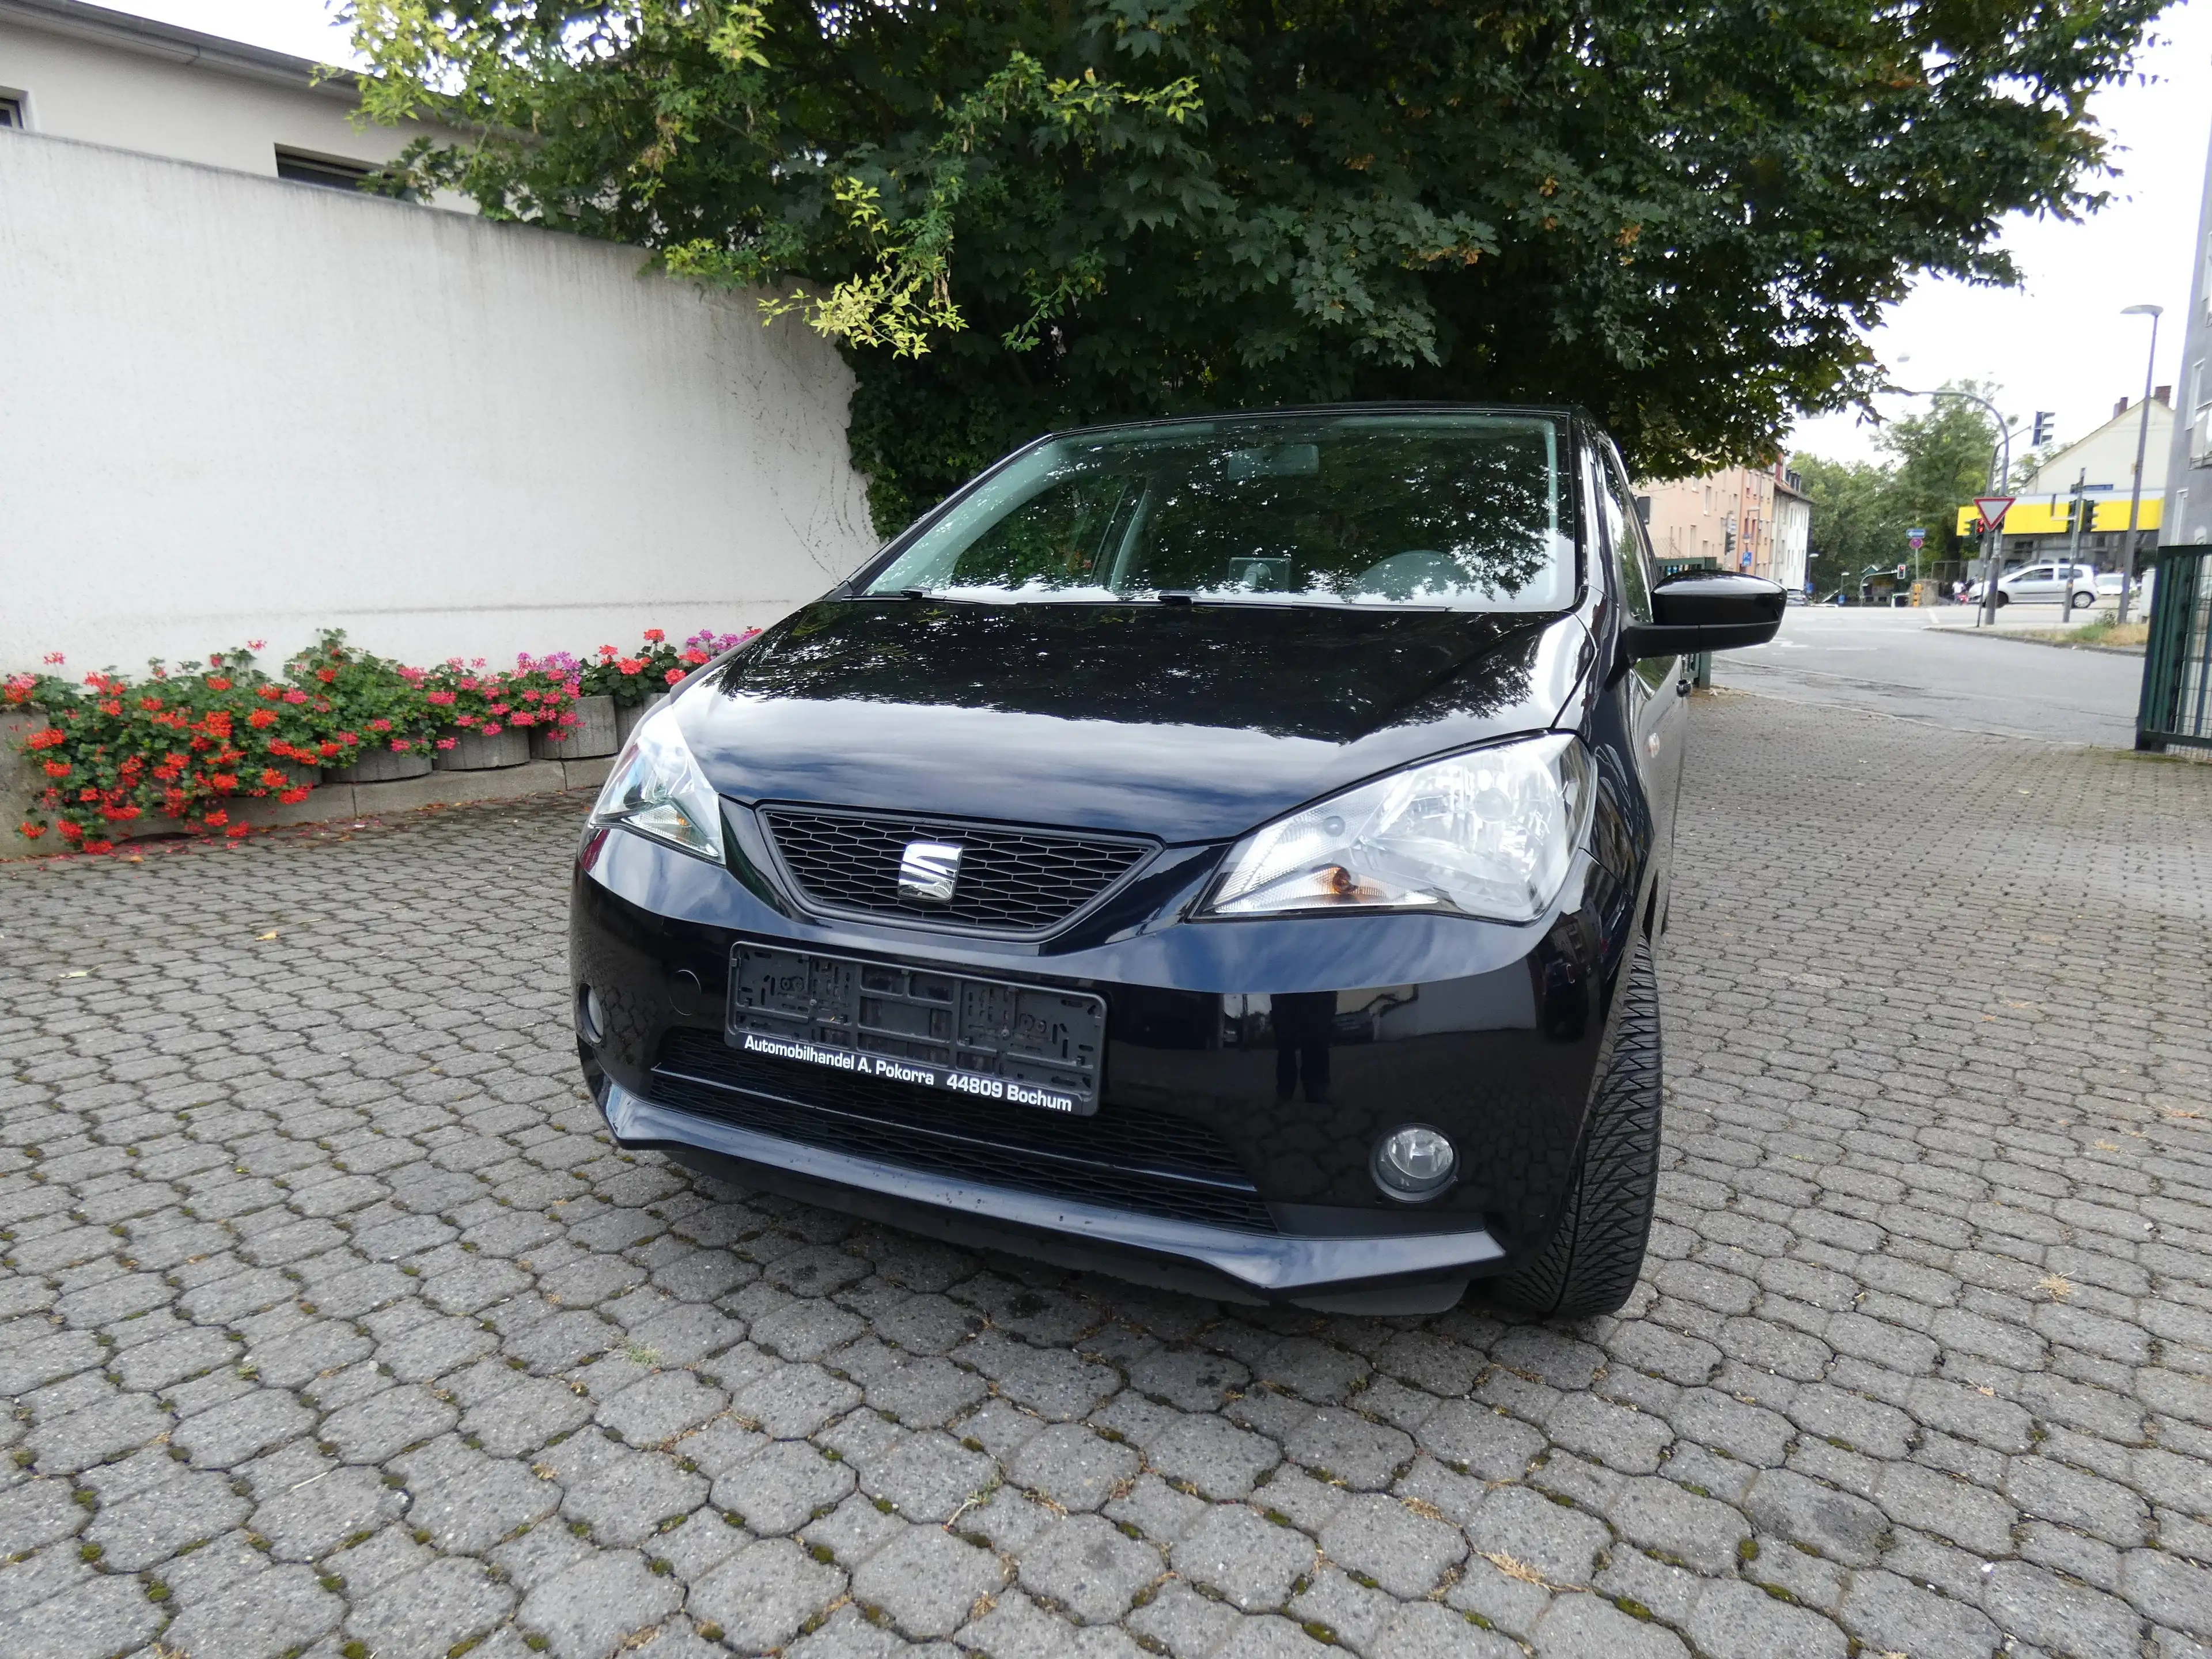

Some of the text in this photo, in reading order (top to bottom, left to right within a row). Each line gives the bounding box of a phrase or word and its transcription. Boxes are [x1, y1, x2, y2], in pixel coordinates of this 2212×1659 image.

[744, 1035, 1072, 1112] Automobilhandel A. Pokorra 44809 Bochum
